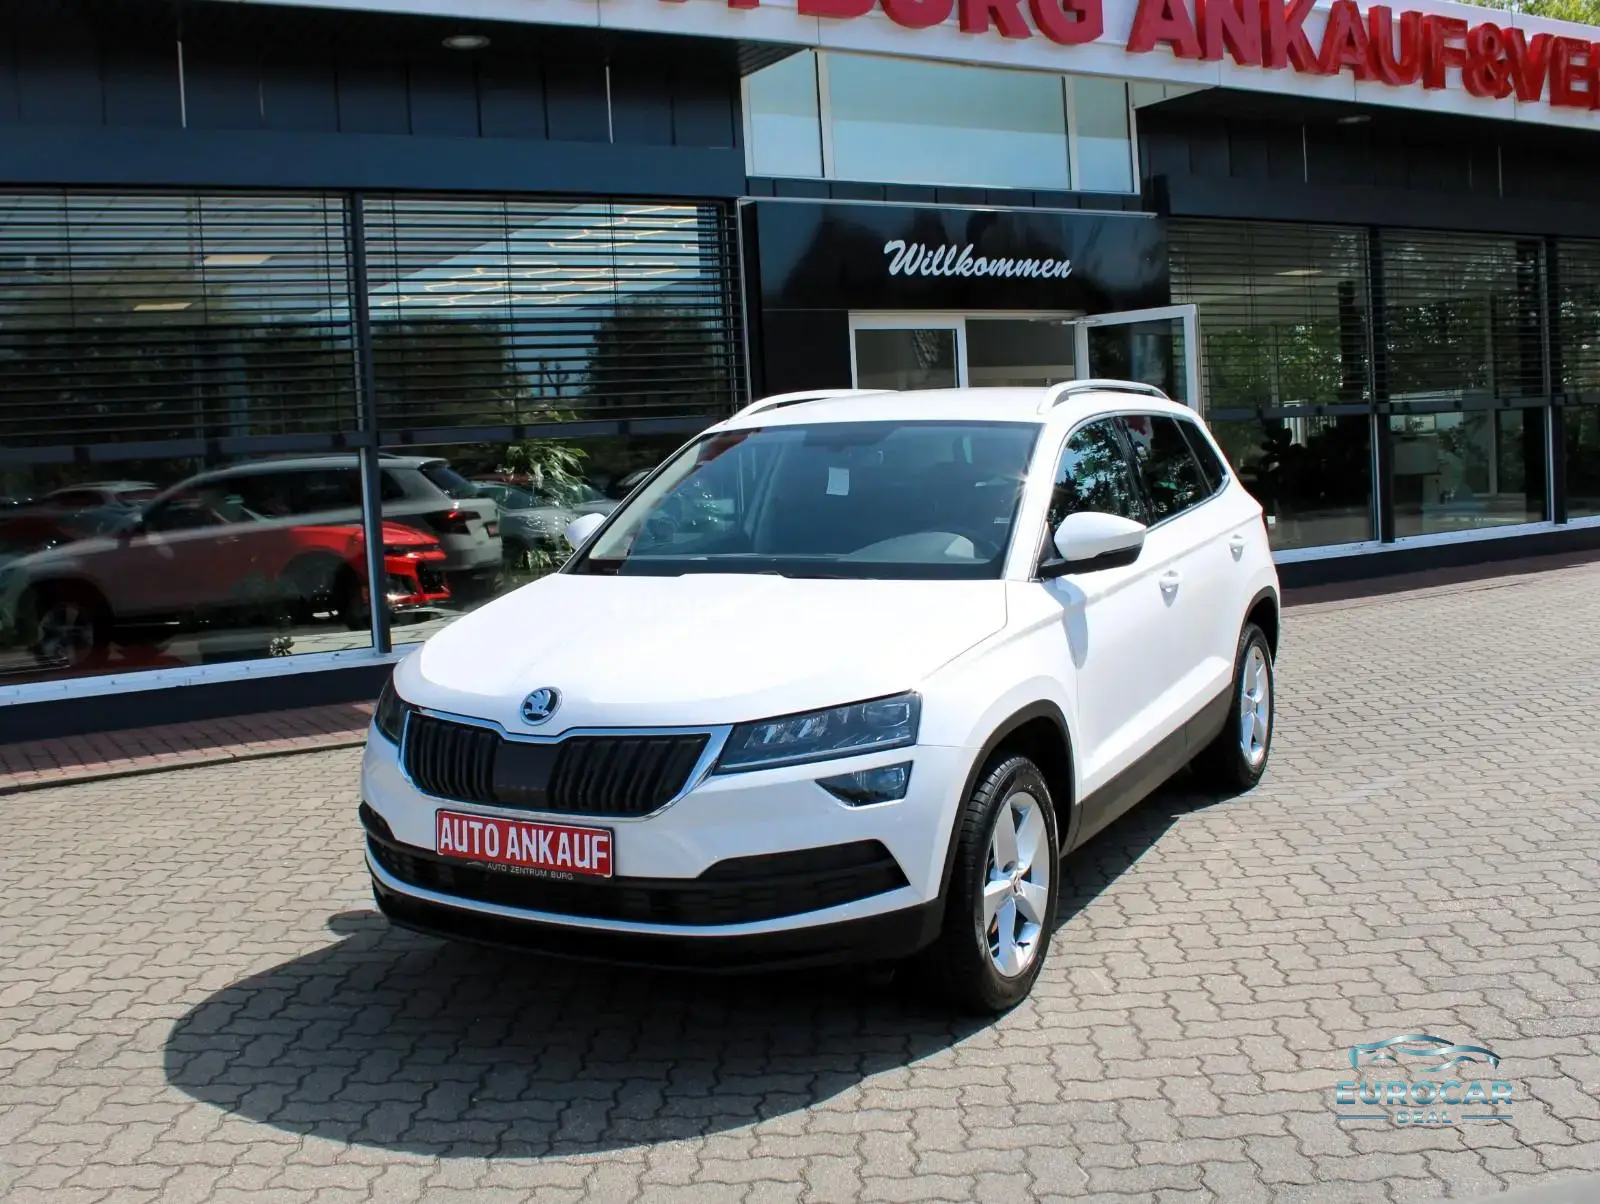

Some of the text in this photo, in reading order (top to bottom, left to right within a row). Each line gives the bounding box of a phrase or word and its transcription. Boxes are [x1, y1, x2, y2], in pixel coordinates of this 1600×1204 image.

[1125, 0, 1600, 111] ANKAUF&VE
[883, 239, 1072, 279] Willkommen
[440, 816, 609, 870] AUTO ANKAUF
[487, 862, 574, 881] AUTO ZENTRUM BURG
